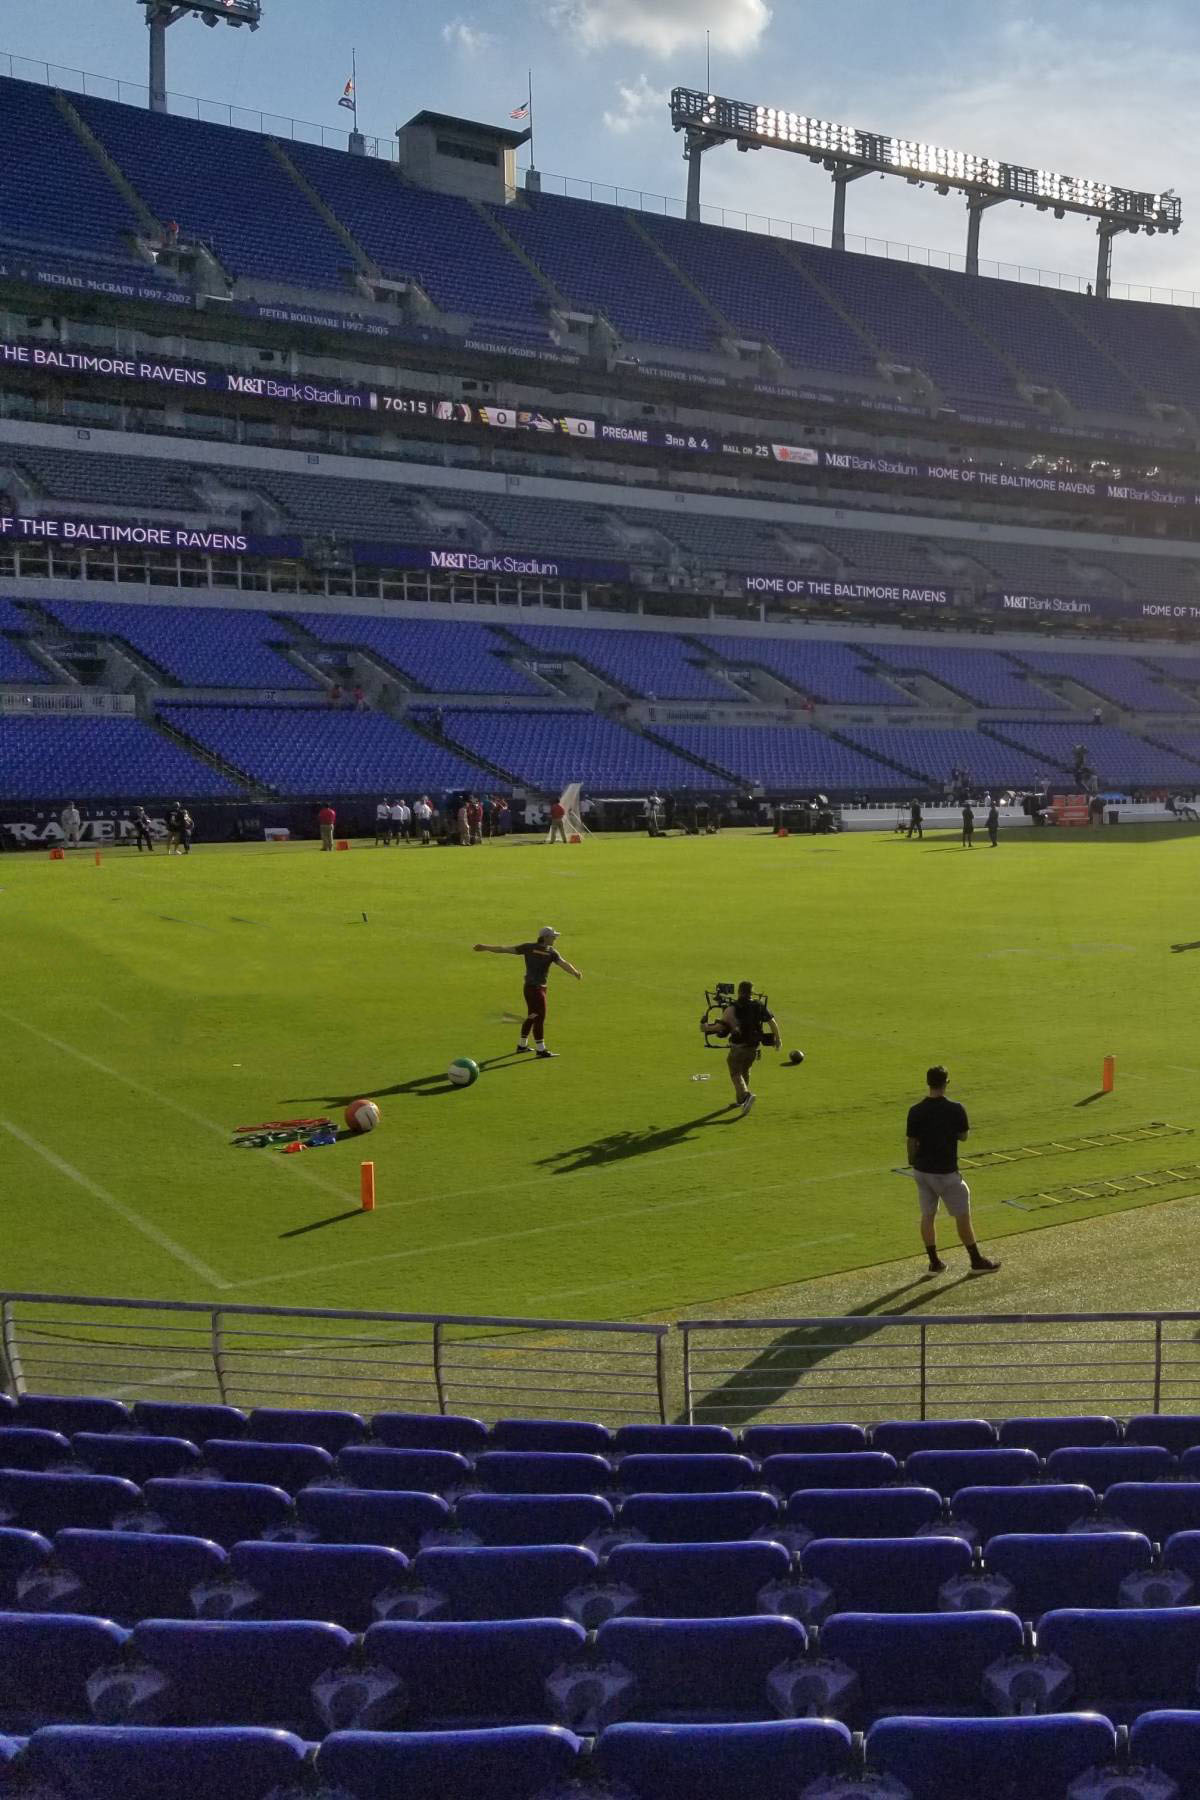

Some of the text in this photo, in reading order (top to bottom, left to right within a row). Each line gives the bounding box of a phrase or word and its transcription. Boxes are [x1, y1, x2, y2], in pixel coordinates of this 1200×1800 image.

[38, 271, 191, 304] MICHAEL McCRARY 1997-2002
[259, 307, 389, 336] PETER BOULWARE 1997-2005
[464, 340, 507, 355] JONATHAN
[508, 346, 536, 359] OGDEN
[34, 349, 136, 377] BALTIMORE
[140, 363, 207, 386] RAVENS
[227, 374, 361, 408] M&T Bank Stadium
[383, 396, 428, 414] 70:15
[496, 412, 507, 425] 0
[577, 422, 588, 435] 0
[602, 425, 648, 443] PREGAME
[664, 433, 710, 450] 3RD & 4
[722, 443, 769, 457] BALL ON 25
[825, 452, 852, 468] M&T
[852, 455, 877, 471] Bank
[878, 458, 918, 476] Stadium
[928, 466, 1096, 496] HOME OF THE BALTIMORE RAVENS
[1107, 485, 1186, 505] M&T Bank Stadium
[0, 518, 247, 551] F THE BALTIMORE RAVENS
[430, 551, 559, 576] M&T Bank Stadium
[747, 577, 946, 603] HOME OF THE BALTIMORE RAVENS
[1003, 595, 1091, 614] M&T Bank Stadium
[1142, 603, 1170, 616] HOME
[1173, 605, 1187, 617] OF
